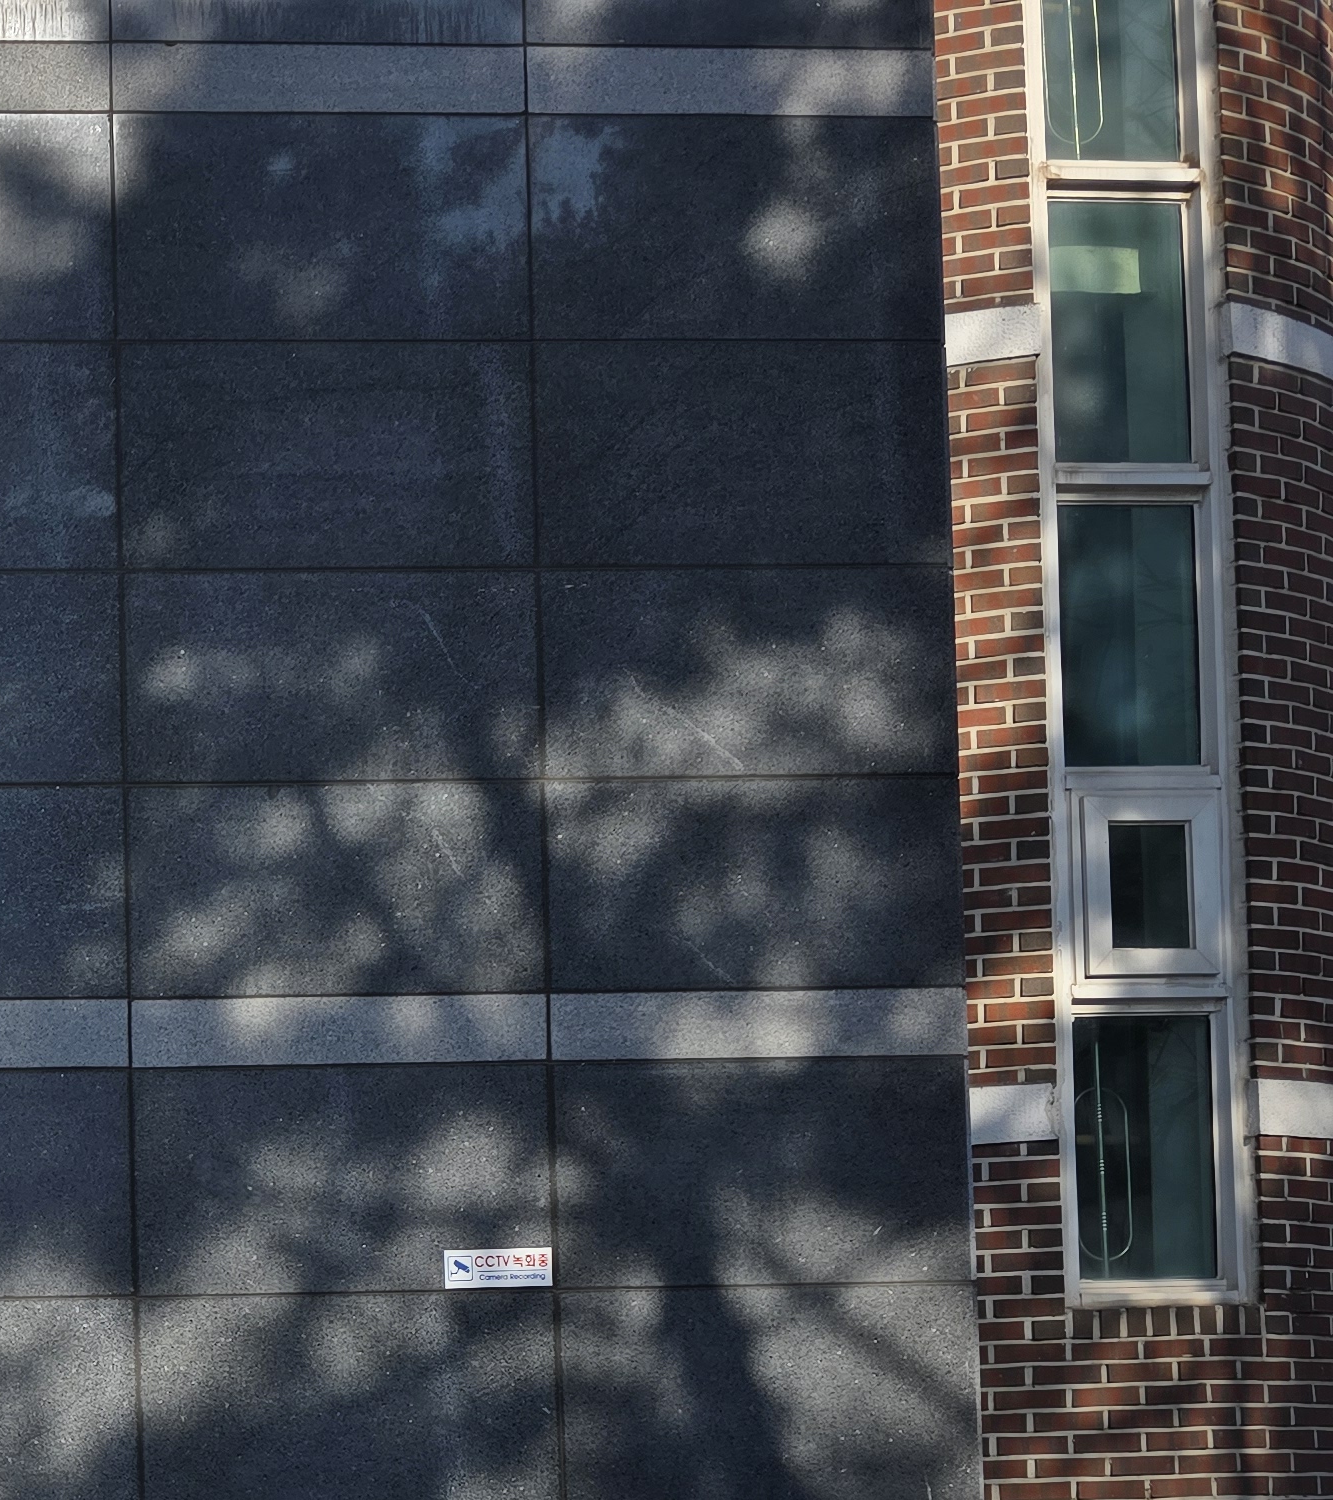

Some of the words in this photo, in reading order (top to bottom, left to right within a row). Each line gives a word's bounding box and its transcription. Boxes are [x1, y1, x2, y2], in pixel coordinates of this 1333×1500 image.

[474, 1255, 510, 1268] CCTV
[512, 1253, 549, 1267] 녹화중
[509, 1272, 546, 1281] Recording
